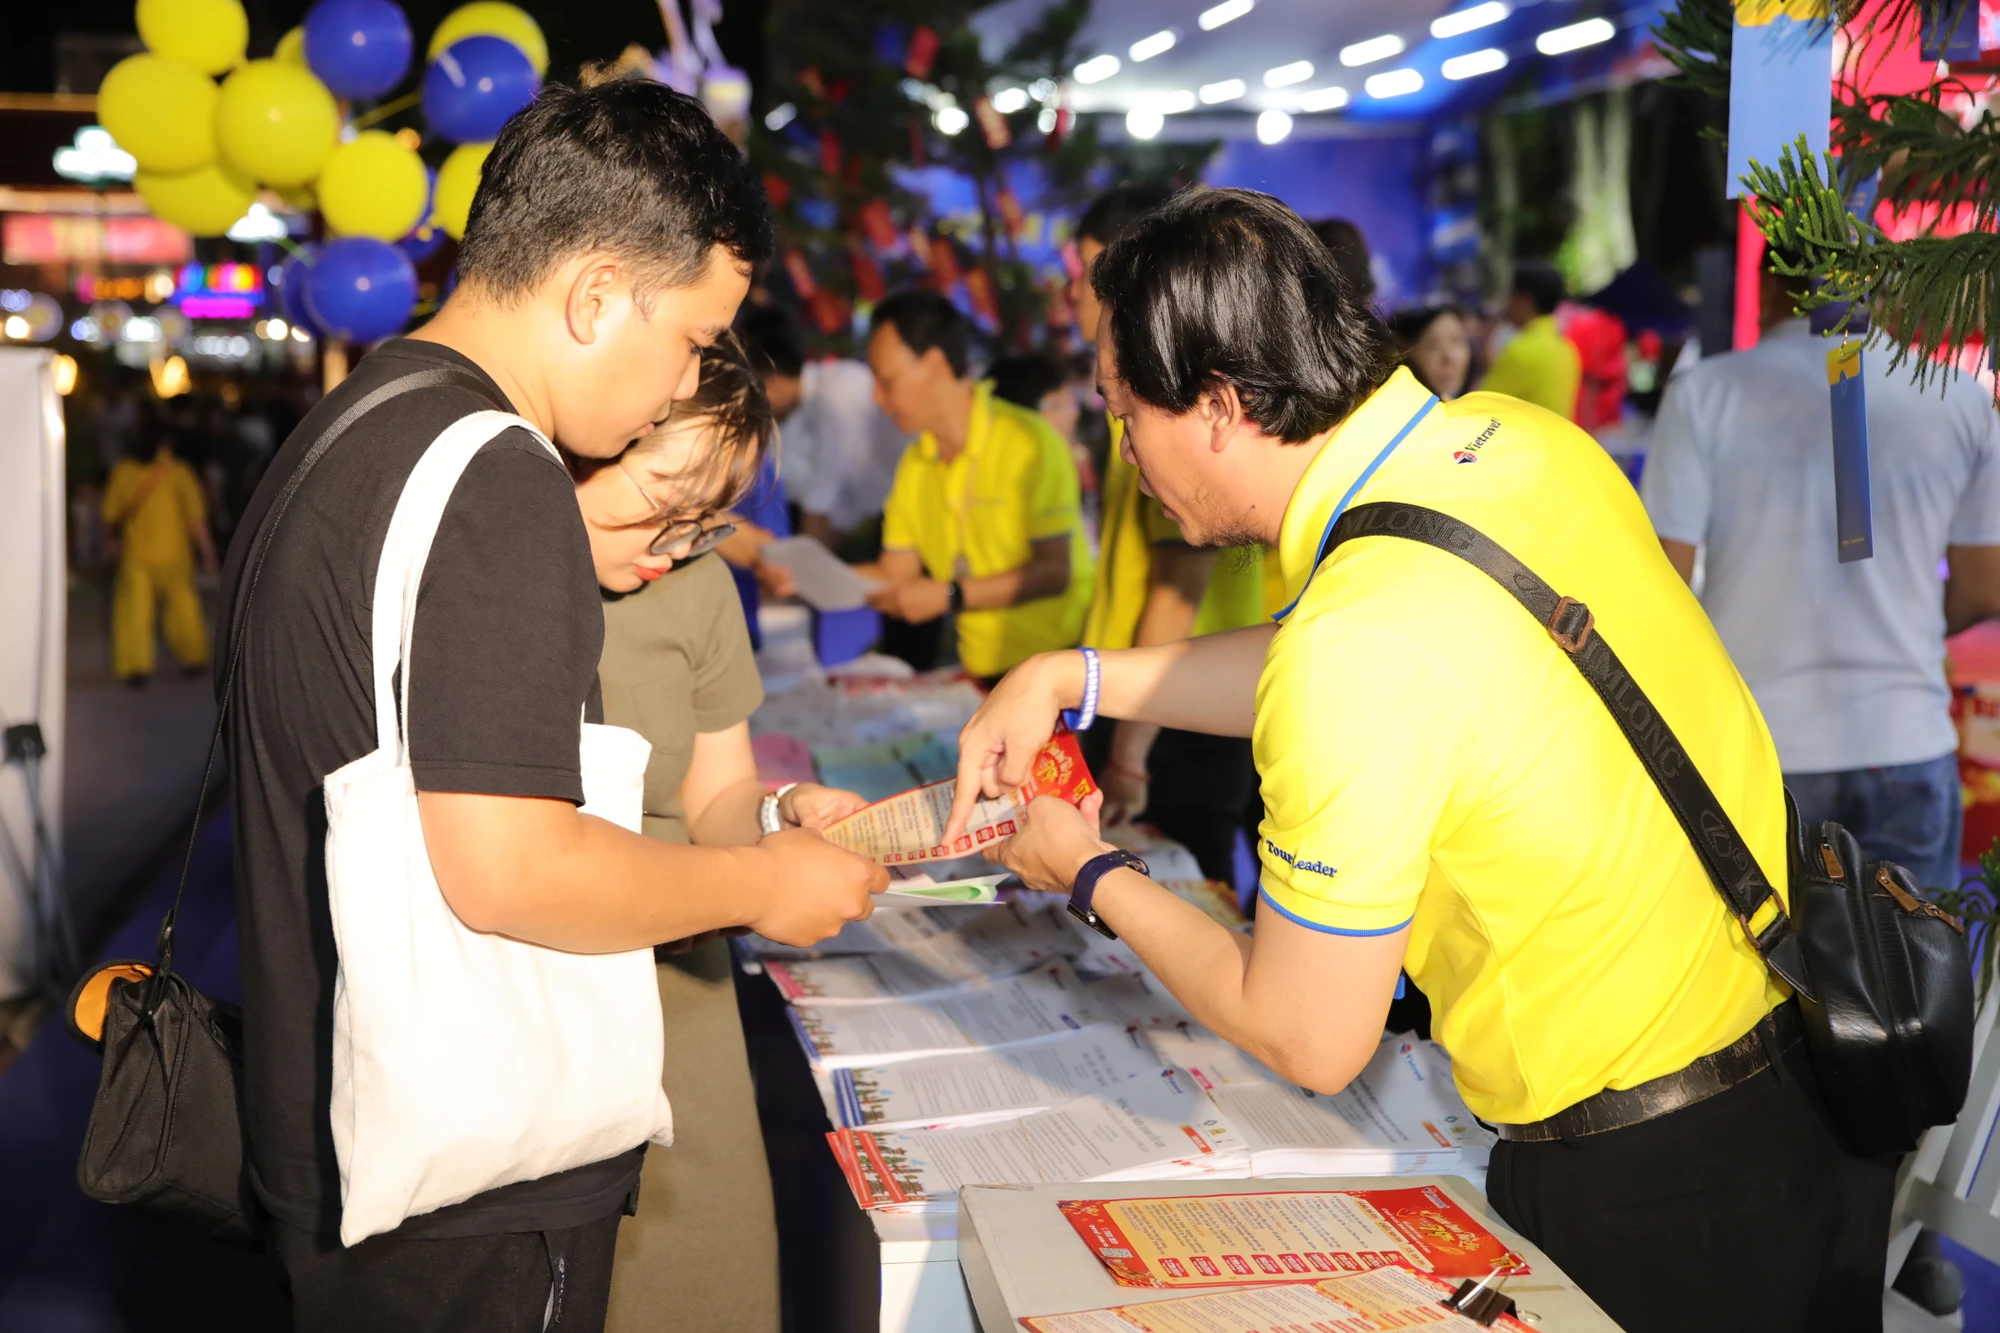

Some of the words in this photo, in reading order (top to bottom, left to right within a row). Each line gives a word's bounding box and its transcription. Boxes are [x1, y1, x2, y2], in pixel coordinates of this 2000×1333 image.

[1464, 418, 1502, 452] Vietravel
[1334, 506, 1475, 551] MLONG
[1265, 838, 1293, 865] Tour
